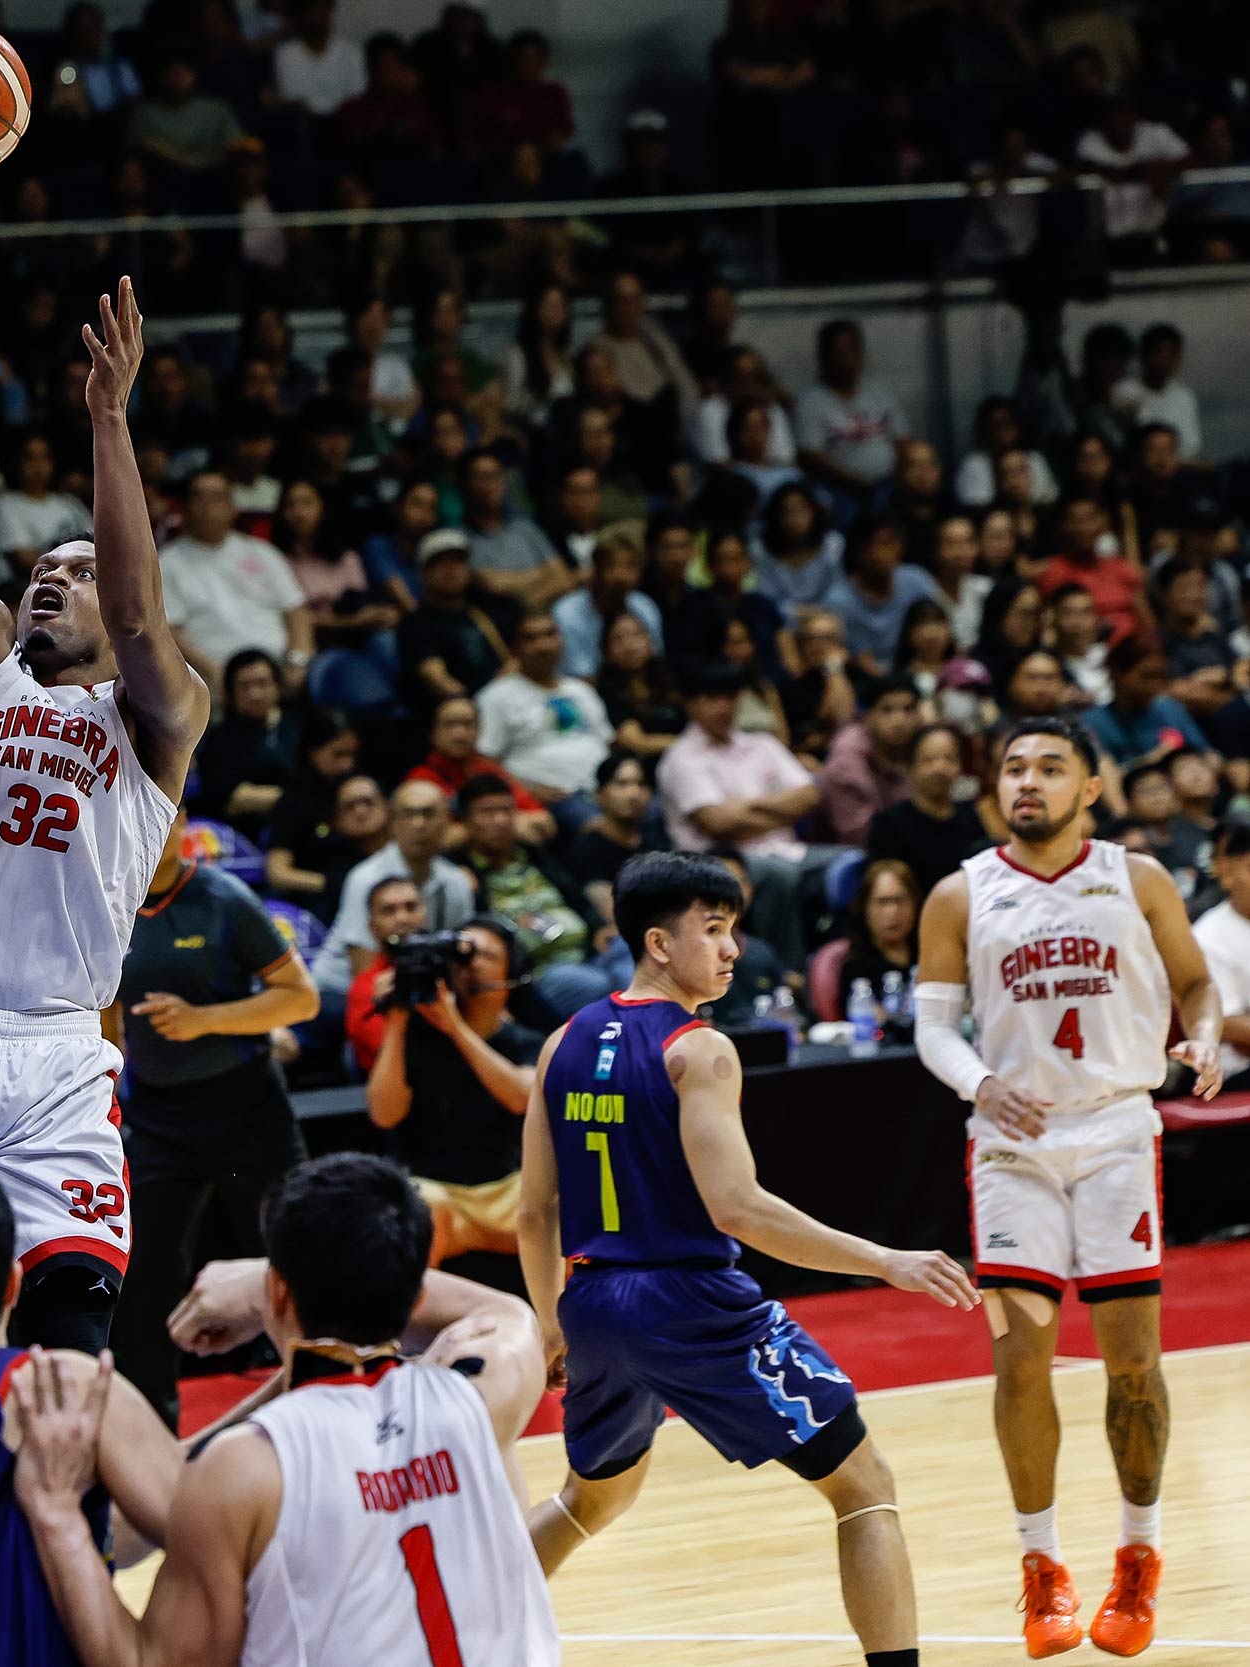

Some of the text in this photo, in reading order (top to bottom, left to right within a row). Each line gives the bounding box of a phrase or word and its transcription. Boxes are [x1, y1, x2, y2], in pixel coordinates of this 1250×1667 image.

[20, 694, 106, 724] BARNGAY
[37, 751, 98, 799] MIGUEL
[0, 783, 80, 853] 32
[1000, 936, 1120, 990] GINEBRA
[1011, 976, 1113, 1003] SAN MIGUEL
[1052, 1007, 1084, 1060] 4
[60, 1179, 125, 1240] 32
[1129, 1210, 1153, 1252] 4
[398, 1523, 464, 1667] 1
